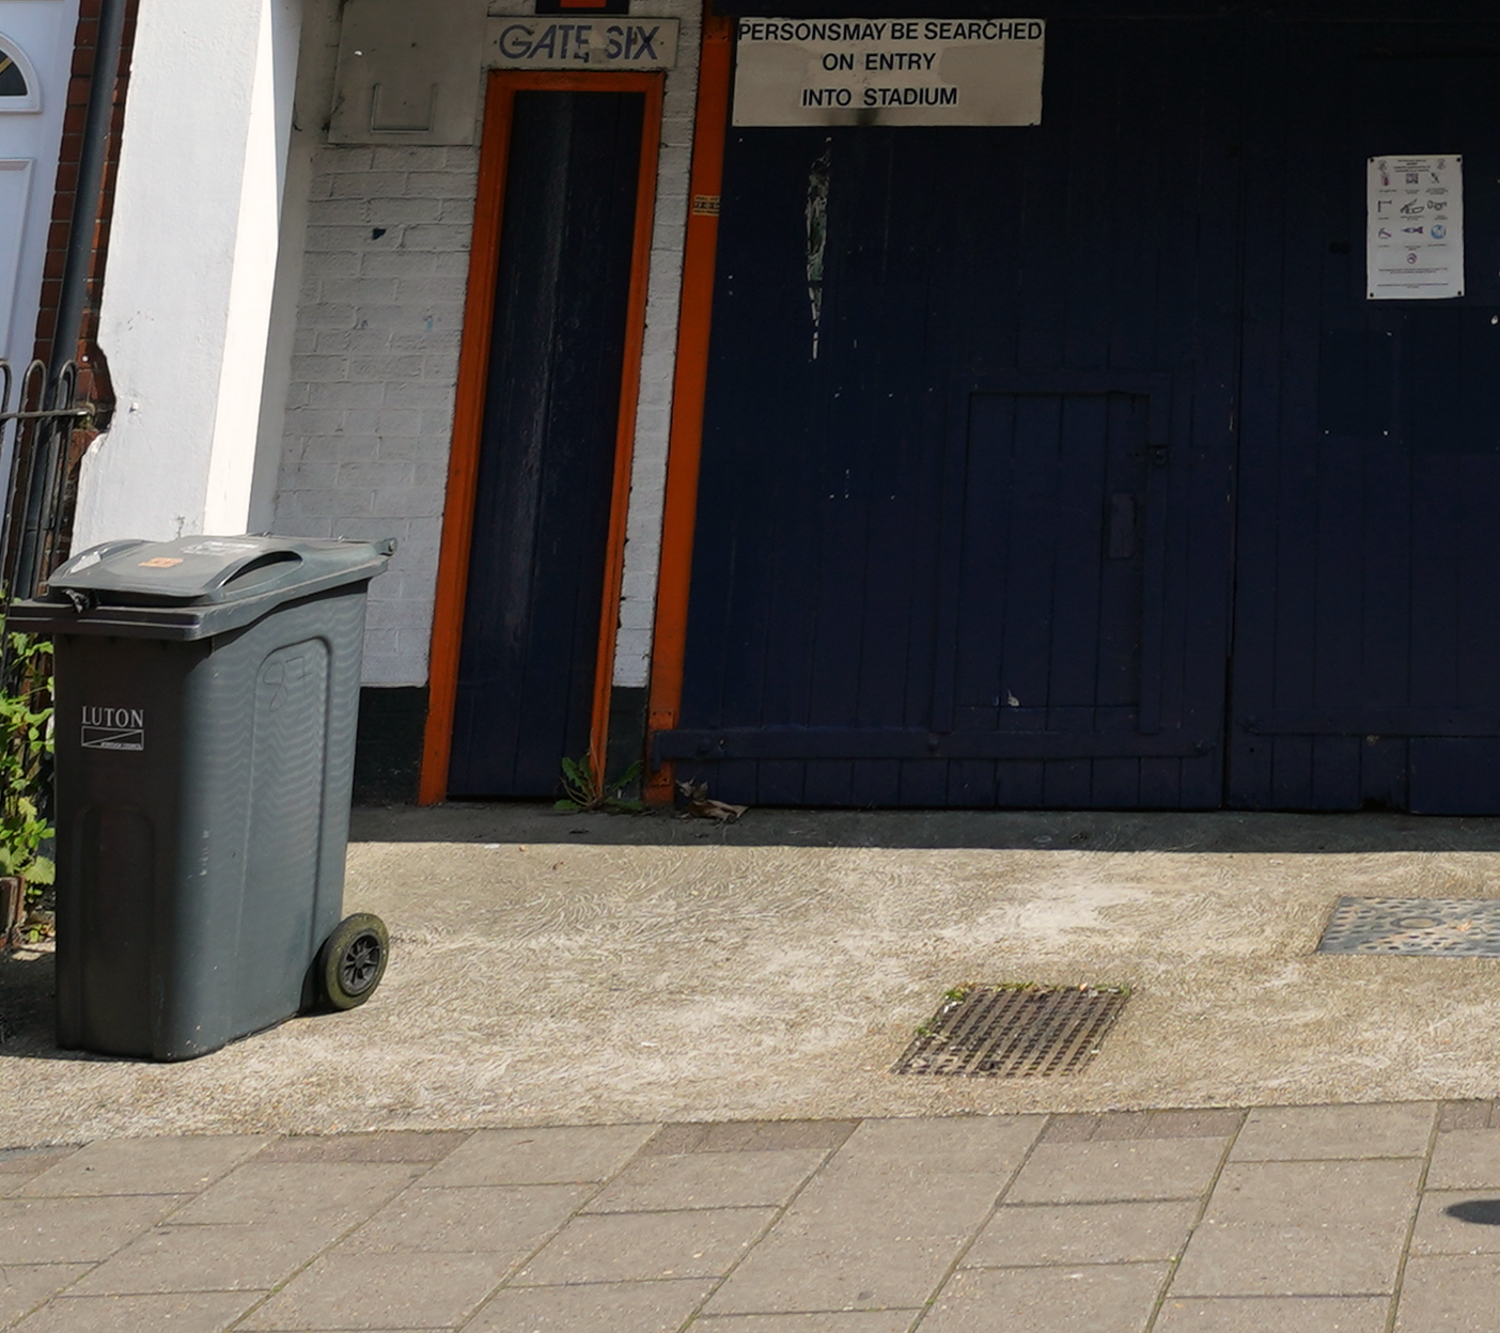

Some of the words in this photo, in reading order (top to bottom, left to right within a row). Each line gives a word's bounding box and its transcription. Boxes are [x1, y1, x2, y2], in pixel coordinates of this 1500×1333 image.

[890, 23, 919, 40] BE
[924, 22, 1043, 40] SEARCHED
[499, 24, 592, 59] GATE
[606, 25, 660, 60] SIX
[822, 53, 853, 71] ON
[865, 52, 936, 71] ENTRY
[802, 88, 852, 106] INTO
[863, 88, 957, 106] STADIUM
[81, 705, 145, 728] LUTON
